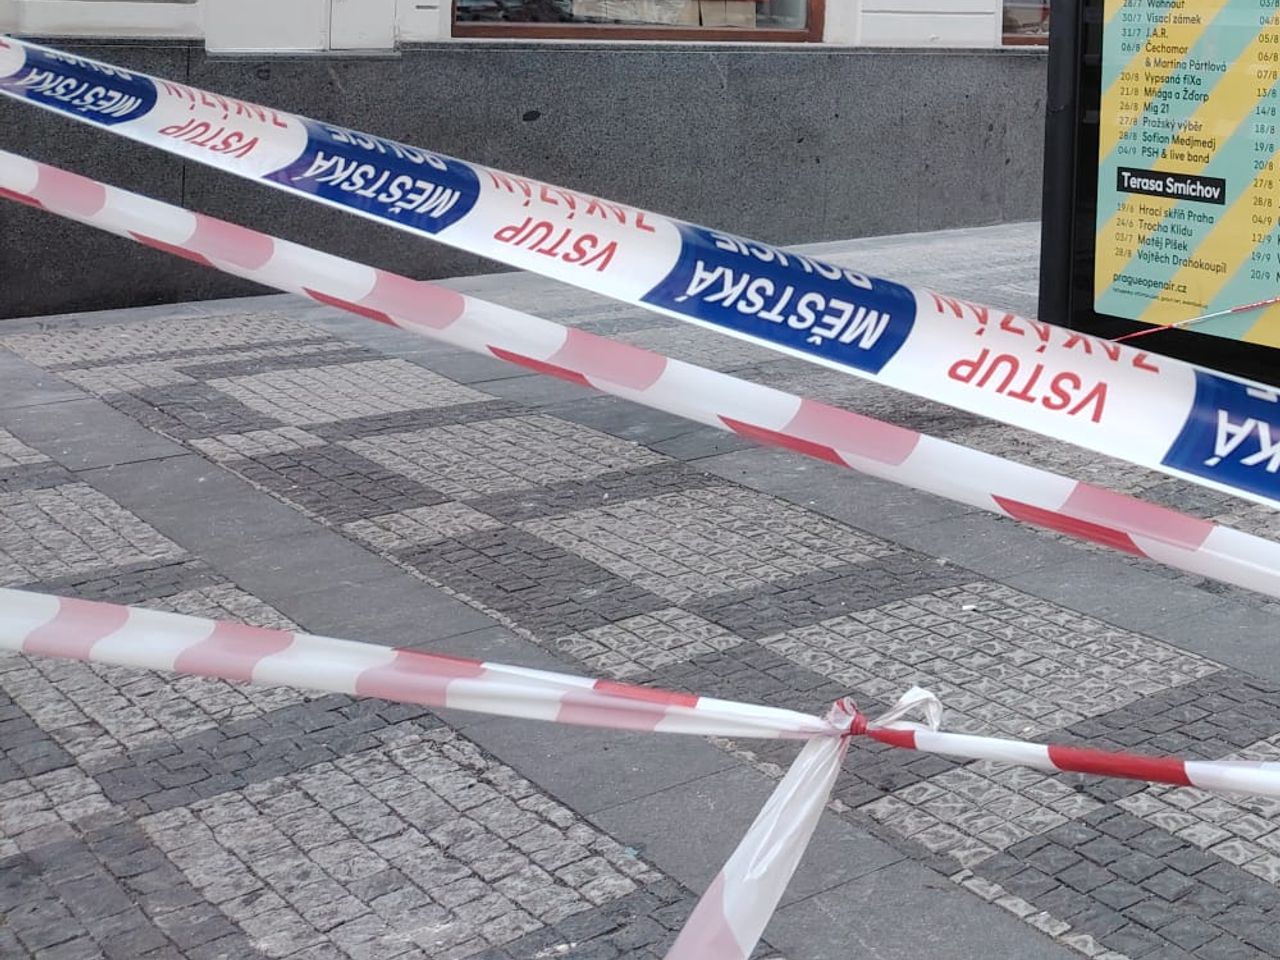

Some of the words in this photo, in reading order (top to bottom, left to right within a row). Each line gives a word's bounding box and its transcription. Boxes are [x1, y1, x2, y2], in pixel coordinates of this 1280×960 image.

[1173, 14, 1201, 24] zámek
[1121, 28, 1142, 37] 31/7
[1146, 27, 1168, 38] J.A.R.
[1258, 34, 1279, 43] 05/8
[1145, 40, 1188, 54] Čechomor
[1145, 58, 1151, 67] &
[1153, 58, 1187, 69] Martina
[1144, 72, 1181, 85] Vypsaná
[1257, 70, 1277, 80] 07/8
[10, 66, 142, 123] MĚSTSKÁ
[1143, 102, 1159, 115] Mig
[1161, 103, 1169, 113] 21
[1256, 106, 1276, 116] 14/8
[1143, 117, 1175, 131] Pražský
[1178, 120, 1203, 134] výběr
[156, 117, 258, 160] VSTUP
[1142, 131, 1170, 144] Sofian
[1254, 142, 1274, 153] 19/8
[1141, 146, 1159, 158] PSH
[1161, 149, 1167, 159] &
[1169, 149, 1185, 161] live
[1187, 151, 1210, 164] band
[305, 150, 464, 217] MĚSTSKÁ
[1121, 171, 1164, 192] Terasa
[1165, 177, 1221, 199] Smíchov
[1187, 210, 1215, 224] Praha
[1138, 218, 1169, 233] Trocha
[1170, 223, 1193, 237] Klidu
[492, 215, 619, 273] VSTUP
[1137, 234, 1163, 250] Matěj
[1252, 233, 1272, 244] 12/9
[1137, 248, 1170, 265] Vojtěch
[1172, 254, 1228, 274] Drahokoupil
[1251, 251, 1271, 262] 19/9
[1251, 269, 1270, 281] 20/9
[1112, 273, 1187, 294] pragueopenair.cz
[674, 258, 892, 350] MĚSTSKÁ
[947, 346, 1109, 424] VSTUP
